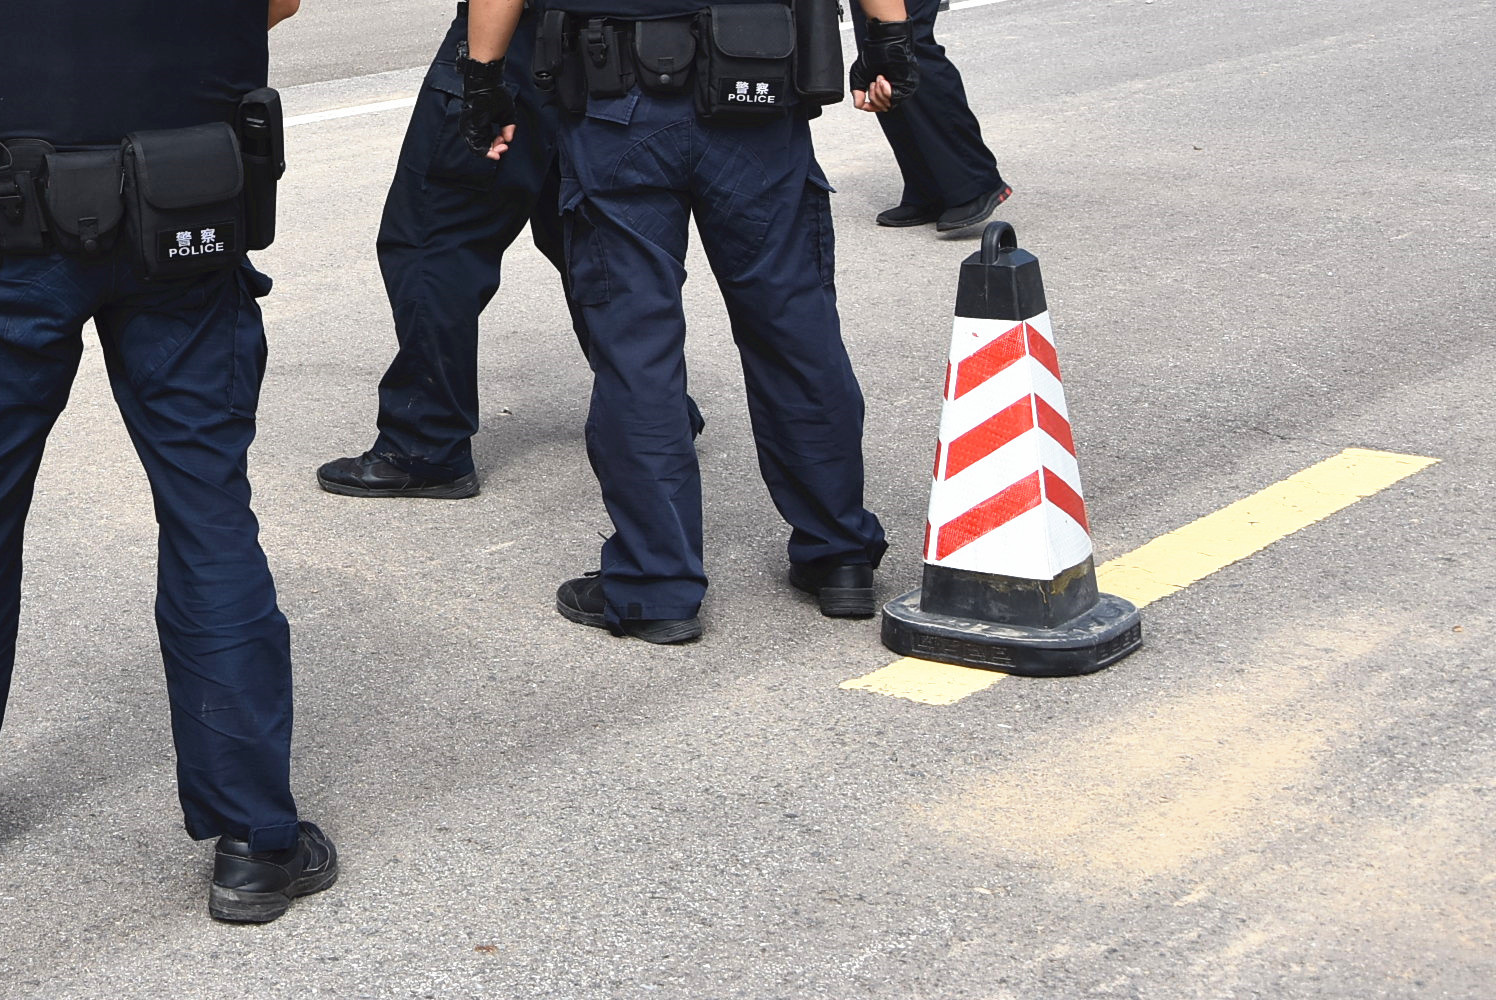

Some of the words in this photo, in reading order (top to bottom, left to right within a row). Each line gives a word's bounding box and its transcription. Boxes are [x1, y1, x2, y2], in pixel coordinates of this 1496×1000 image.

[735, 81, 769, 95] 警察
[727, 93, 776, 104] POLICE
[175, 228, 216, 247] 警察
[168, 242, 225, 258] POLICE
